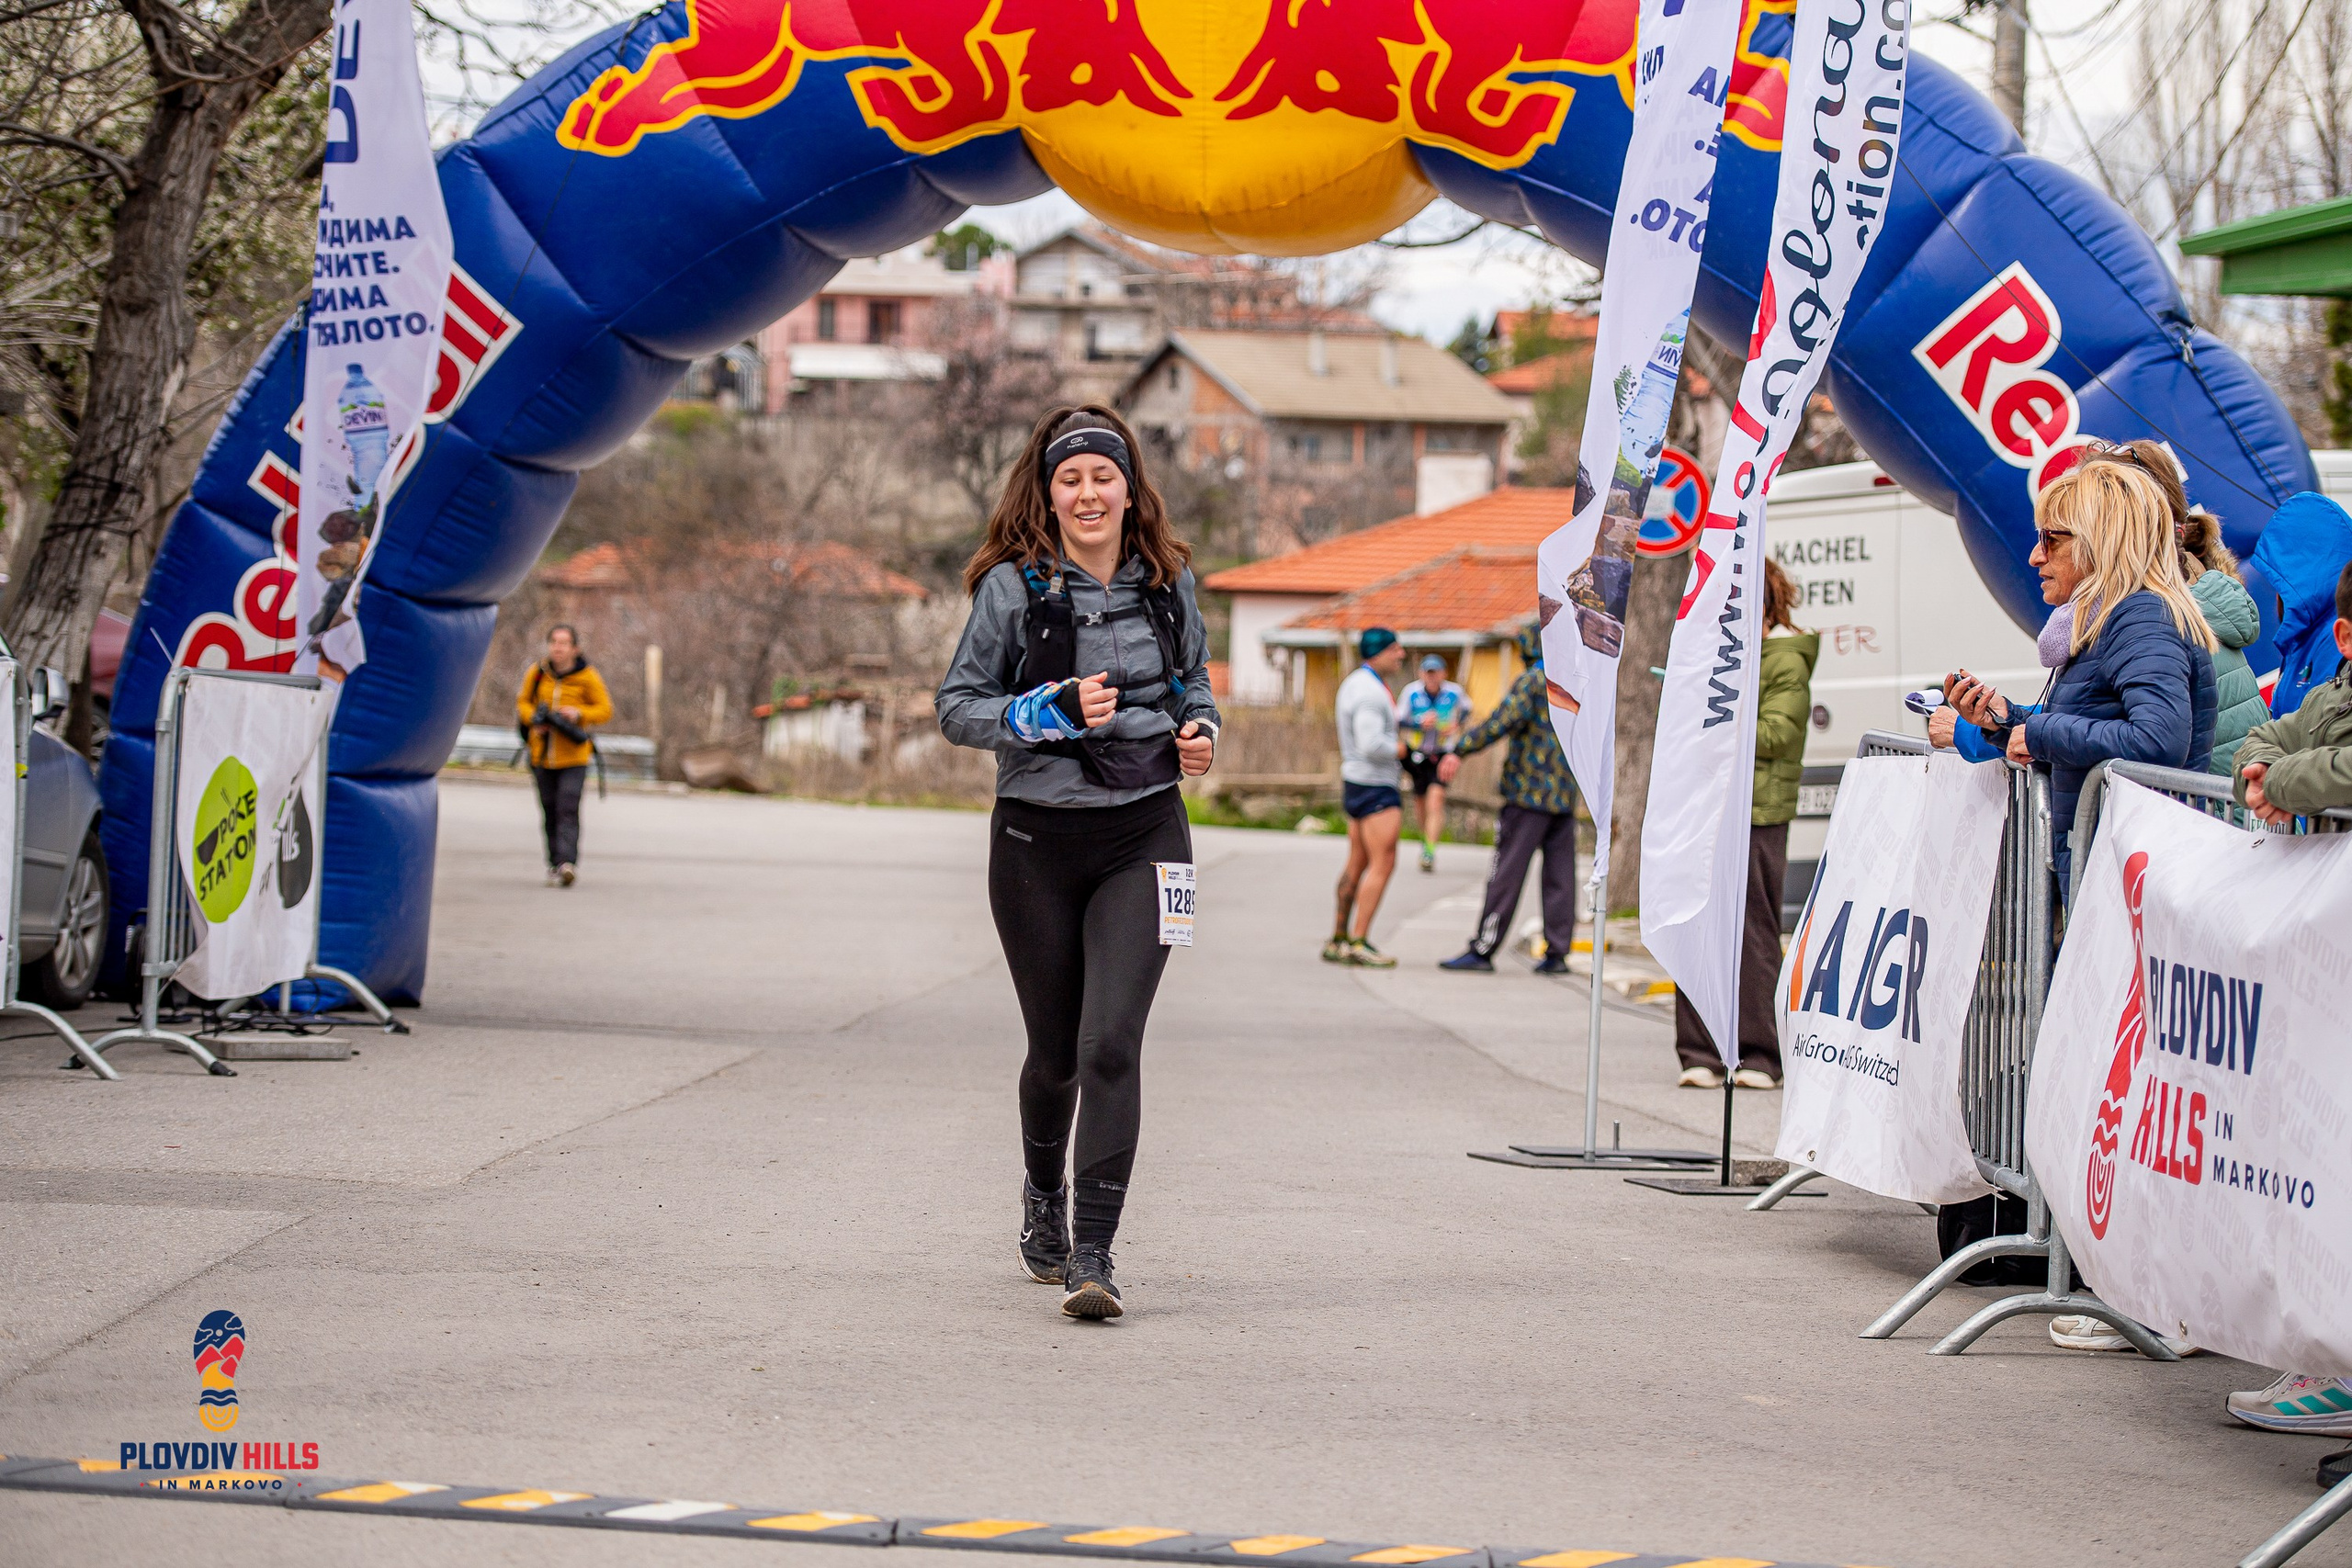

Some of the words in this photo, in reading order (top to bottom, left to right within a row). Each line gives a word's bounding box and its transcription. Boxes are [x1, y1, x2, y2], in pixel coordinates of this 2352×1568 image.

[1774, 536, 1871, 566] KACHEL
[220, 790, 255, 843] POKE
[199, 825, 256, 901] STATON
[2215, 1111, 2233, 1141] IN
[2213, 1155, 2314, 1209] MARKOVO
